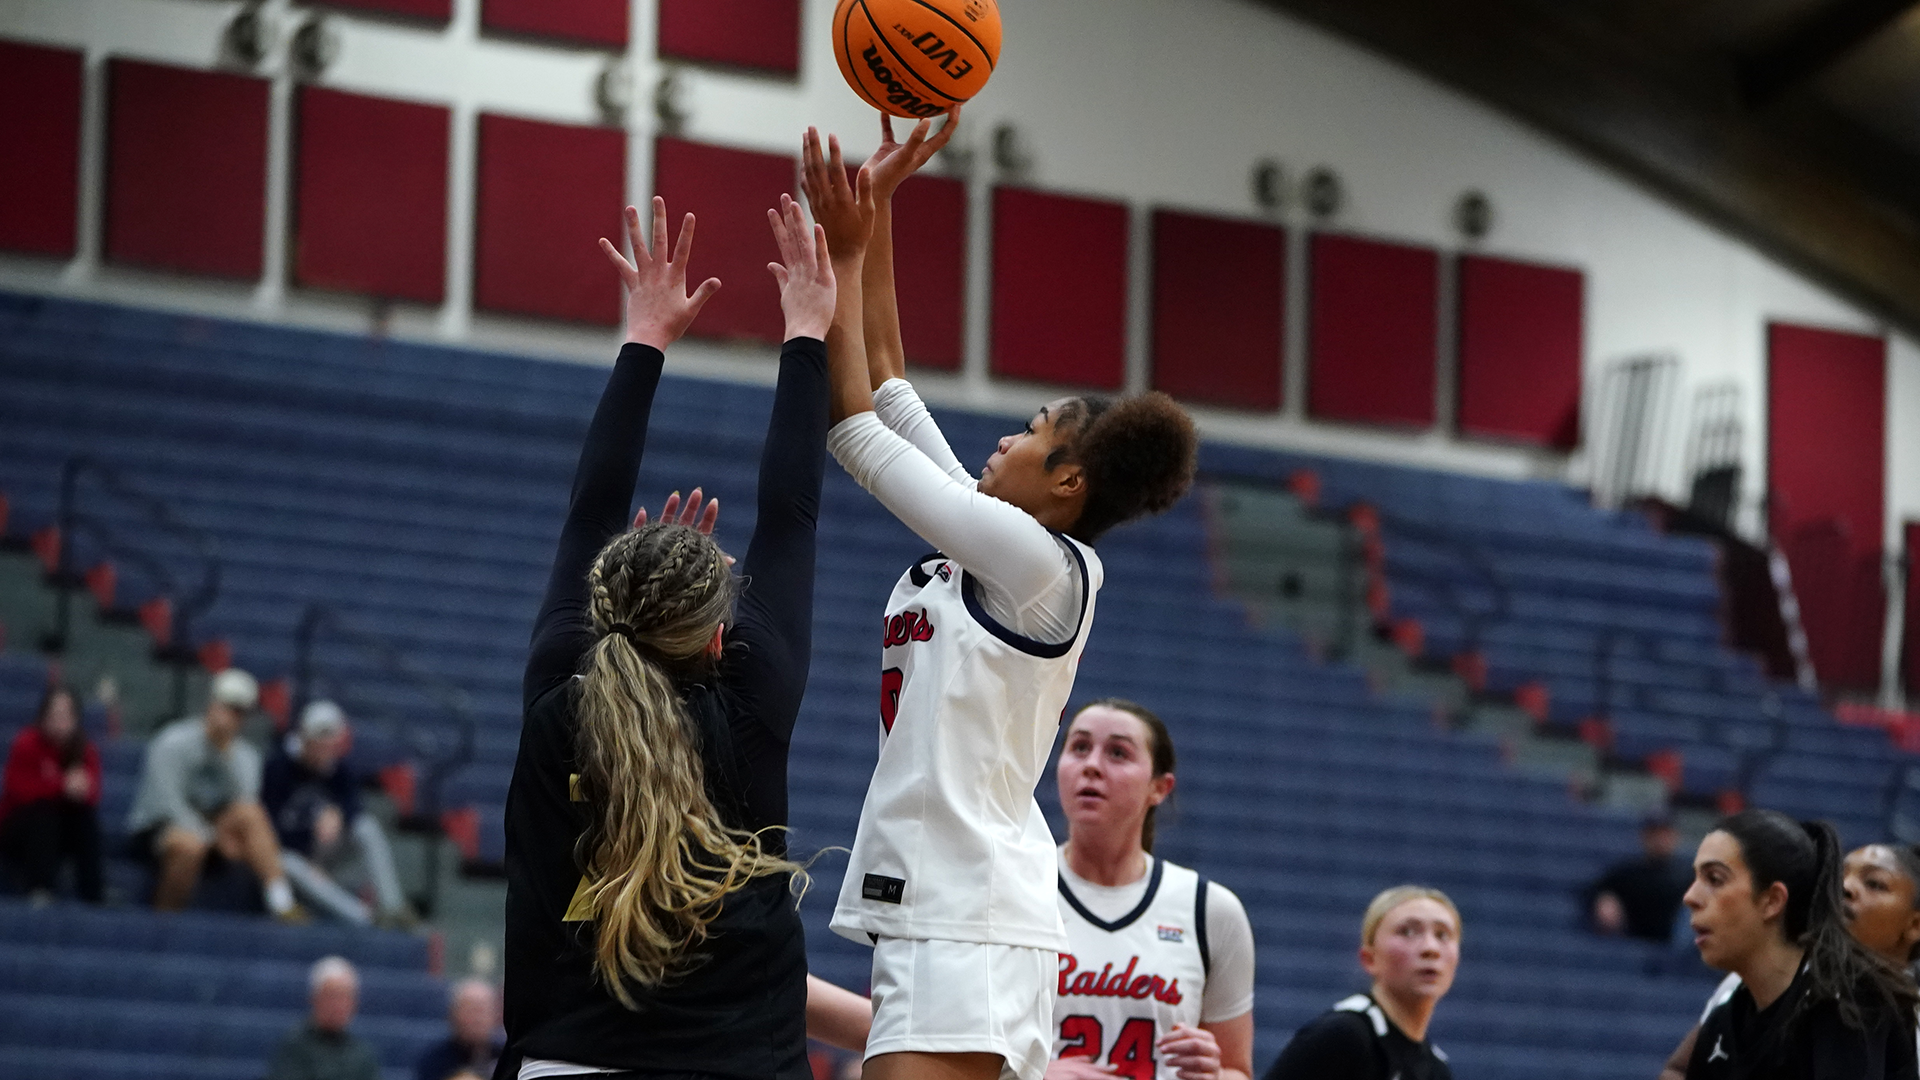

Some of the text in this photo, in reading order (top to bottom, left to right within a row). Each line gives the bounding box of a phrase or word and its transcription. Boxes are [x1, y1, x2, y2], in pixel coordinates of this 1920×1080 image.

[862, 43, 945, 117] Wilson
[887, 884, 897, 895] M
[1058, 953, 1182, 1006] Raiders
[1059, 1014, 1157, 1080] 24
